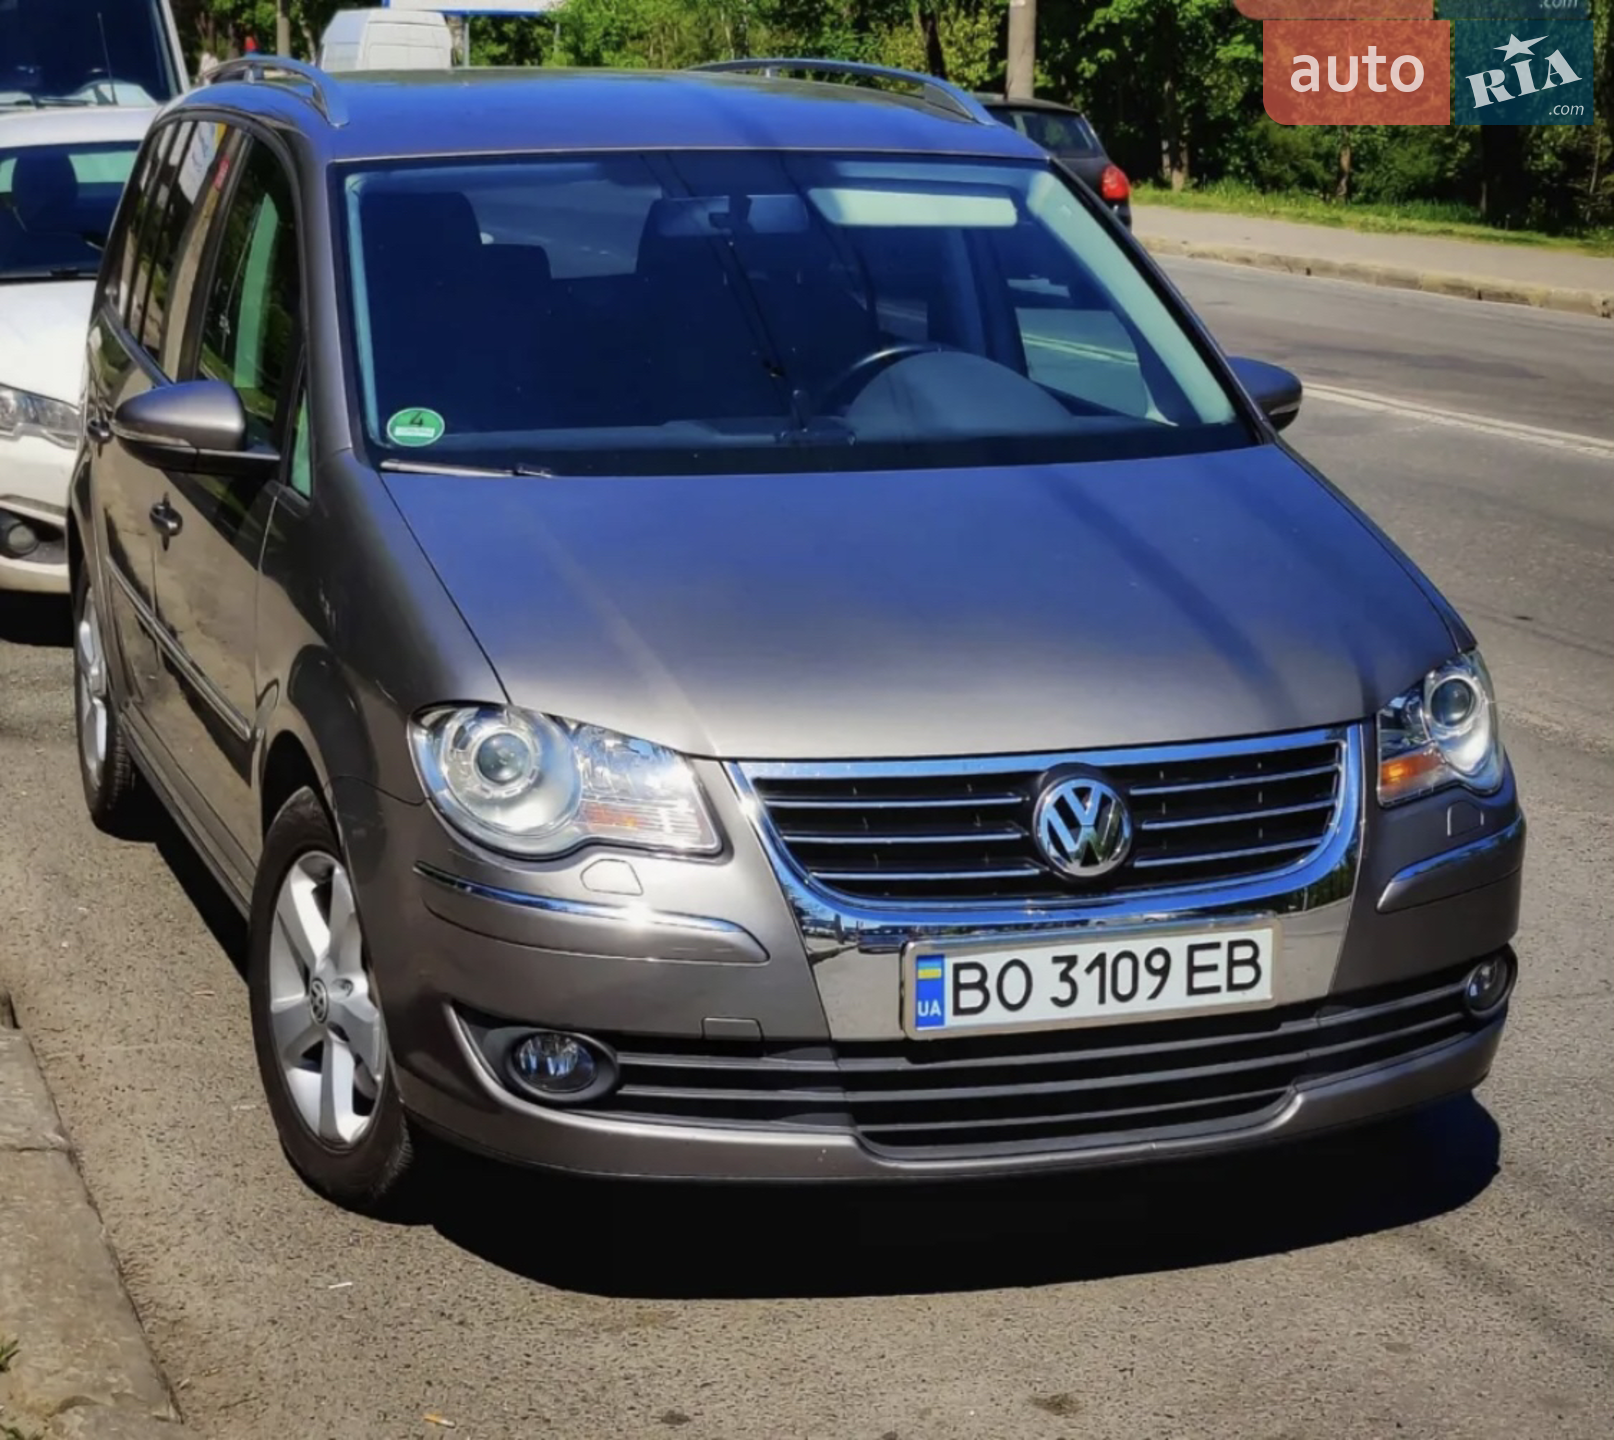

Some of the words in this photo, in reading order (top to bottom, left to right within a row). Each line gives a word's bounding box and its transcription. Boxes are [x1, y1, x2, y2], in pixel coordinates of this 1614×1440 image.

[1036, 776, 1130, 877] VW
[917, 999, 942, 1017] UA
[952, 958, 1033, 1017] BO
[1049, 946, 1172, 1008] 3109
[1186, 938, 1263, 997] EB
